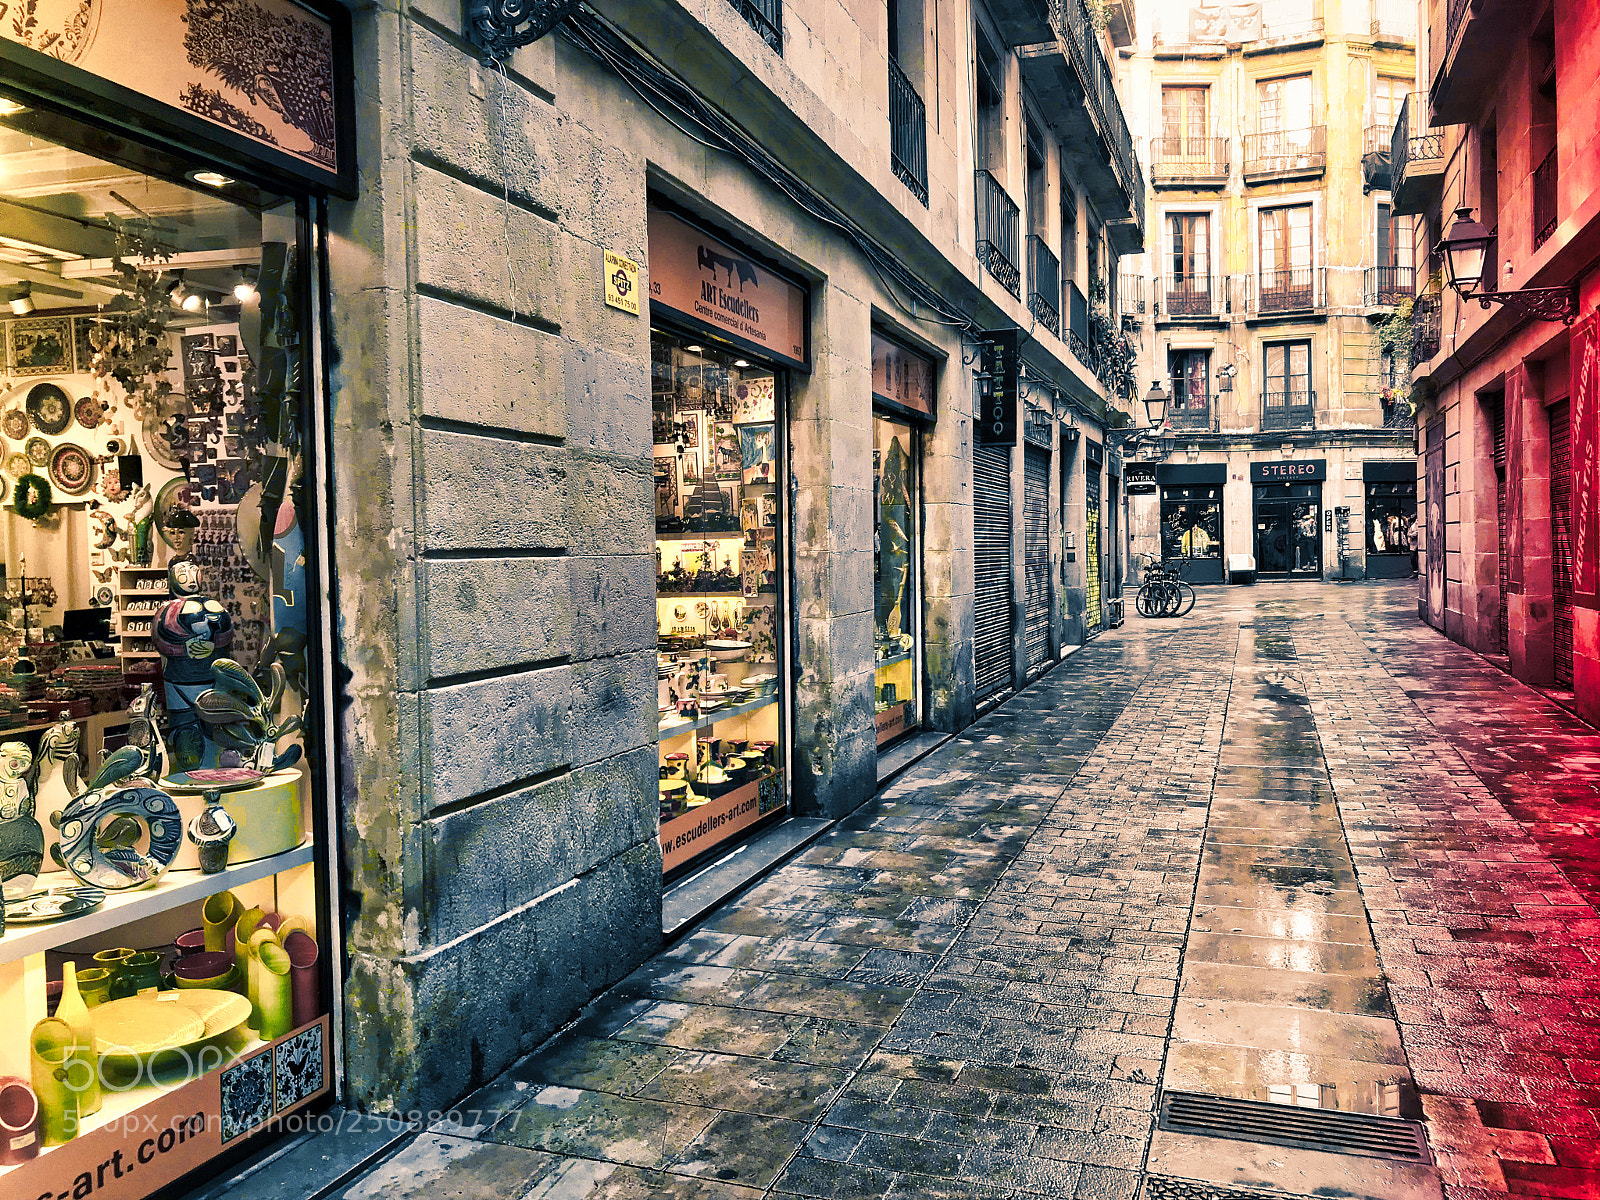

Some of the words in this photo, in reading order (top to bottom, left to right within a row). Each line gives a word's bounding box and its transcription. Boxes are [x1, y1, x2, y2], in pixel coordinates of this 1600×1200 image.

[613, 276, 630, 291] SPITZ
[701, 280, 717, 305] ART
[719, 288, 759, 323] Escudellers
[694, 300, 713, 318] Centre
[714, 311, 739, 329] comercial
[993, 345, 1005, 435] TATTOO
[1262, 464, 1315, 476] STEREO
[1575, 471, 1580, 492] Y
[1575, 440, 1593, 586] HORCHATAS
[661, 797, 757, 855] w.escudellers-art.com
